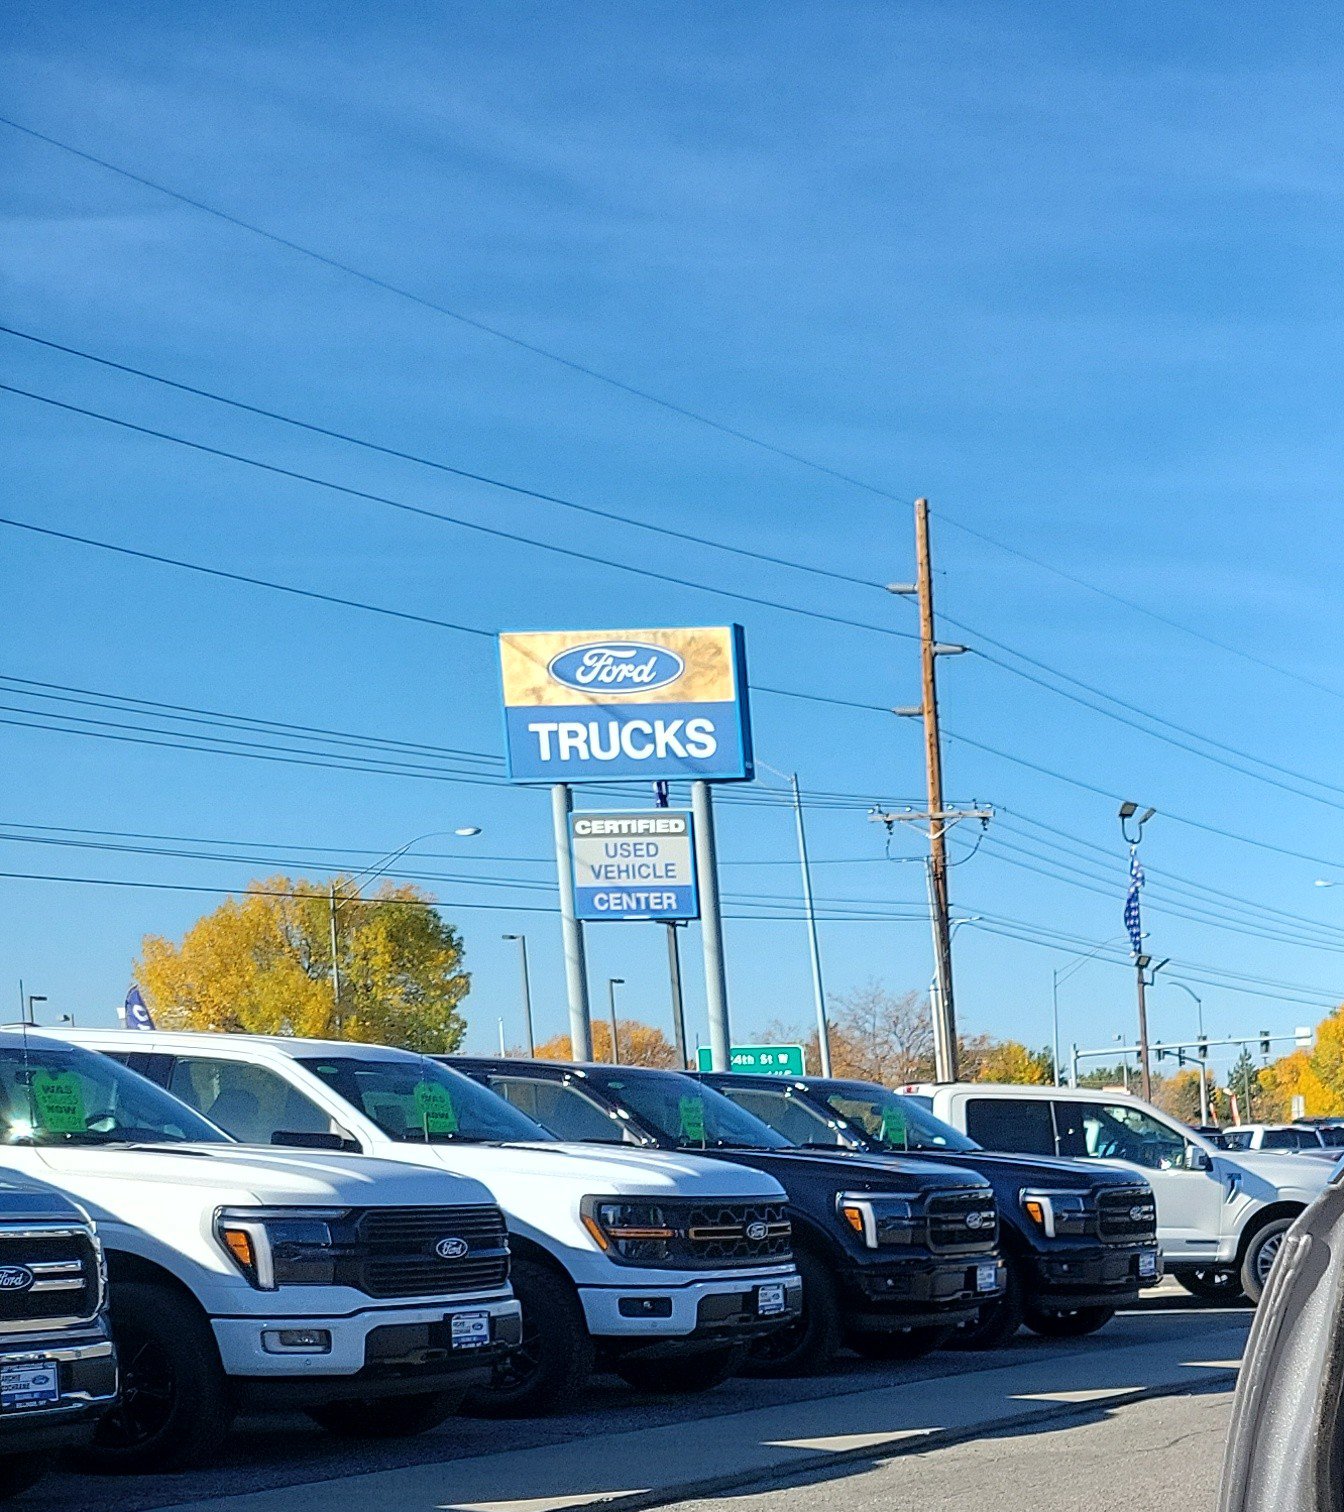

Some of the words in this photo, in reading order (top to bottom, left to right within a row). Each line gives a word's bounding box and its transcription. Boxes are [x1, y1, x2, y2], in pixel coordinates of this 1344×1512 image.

[576, 648, 657, 684] Ford
[528, 718, 717, 761] TRUCKS
[575, 819, 686, 834] CERTIFIED
[604, 842, 659, 858] USED
[590, 863, 677, 880] VEHICLE
[593, 892, 678, 911] CENTER
[730, 1054, 755, 1065] 4th
[760, 1053, 773, 1065] St
[777, 1053, 789, 1064] W
[442, 1241, 463, 1255] Ford
